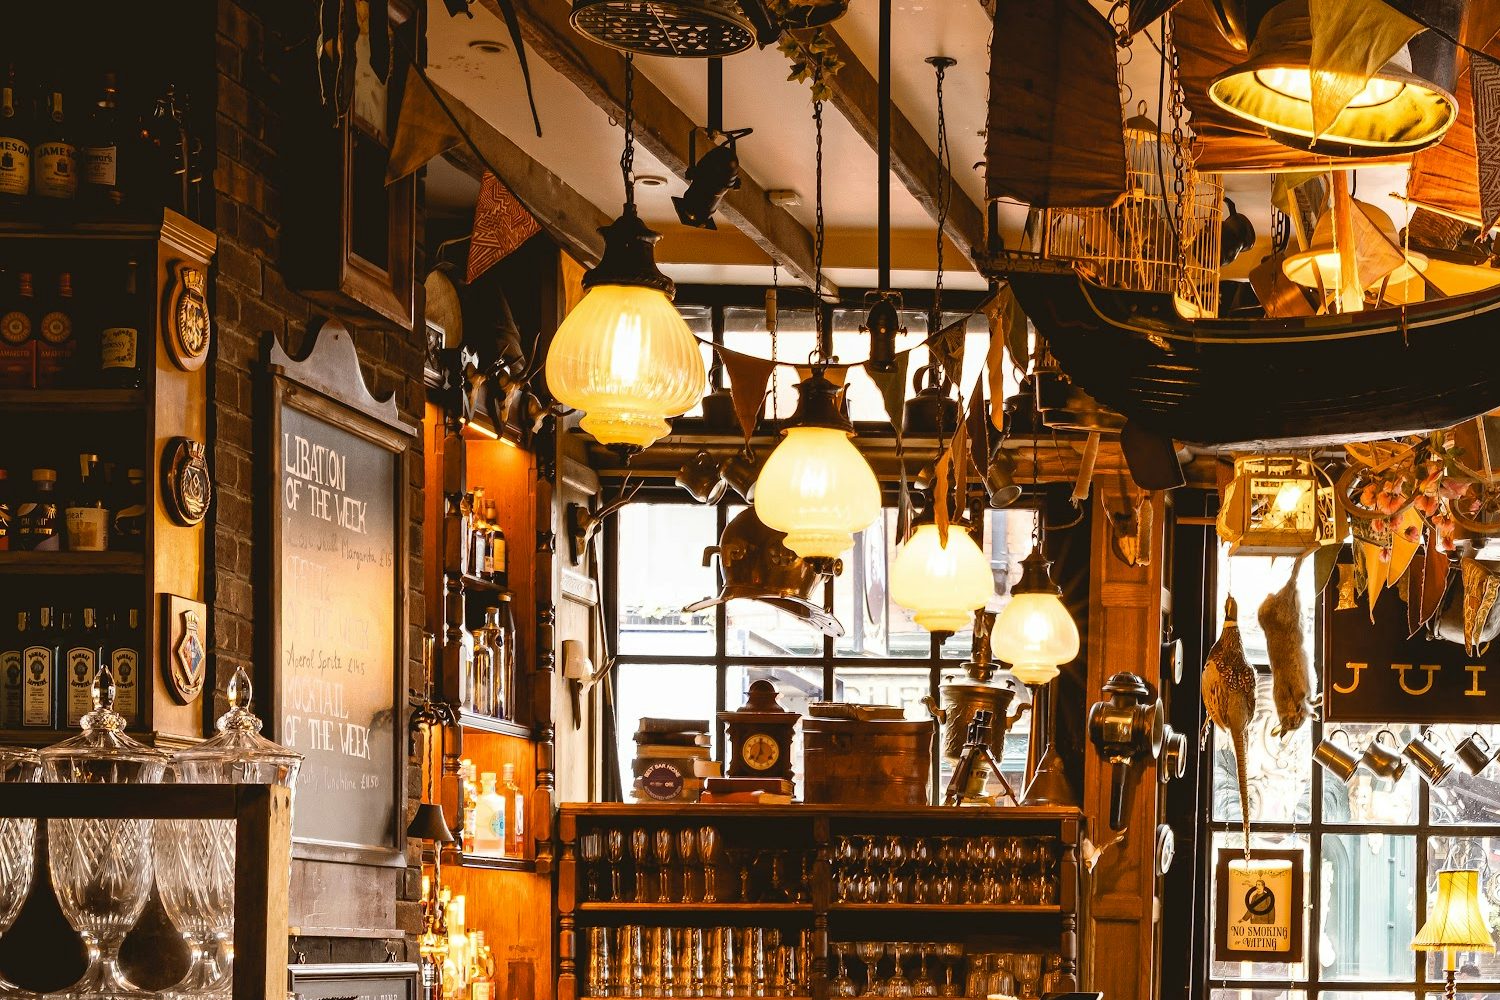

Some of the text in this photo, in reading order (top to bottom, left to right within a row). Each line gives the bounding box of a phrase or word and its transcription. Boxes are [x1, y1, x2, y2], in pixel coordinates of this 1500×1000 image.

[40, 147, 74, 158] JAMES
[285, 433, 346, 492] LIBATION
[285, 477, 302, 511] OF
[308, 484, 332, 521] THE
[334, 493, 368, 534] WEEK
[28, 651, 47, 661] BOMBAY
[286, 641, 316, 676] Aperol
[318, 649, 343, 677] Spritz
[283, 676, 349, 719] MOCKTAIL
[285, 715, 371, 761] OF THE WEEK
[1231, 926, 1288, 940] NO SMOKING
[1243, 937, 1277, 951] VAPING
